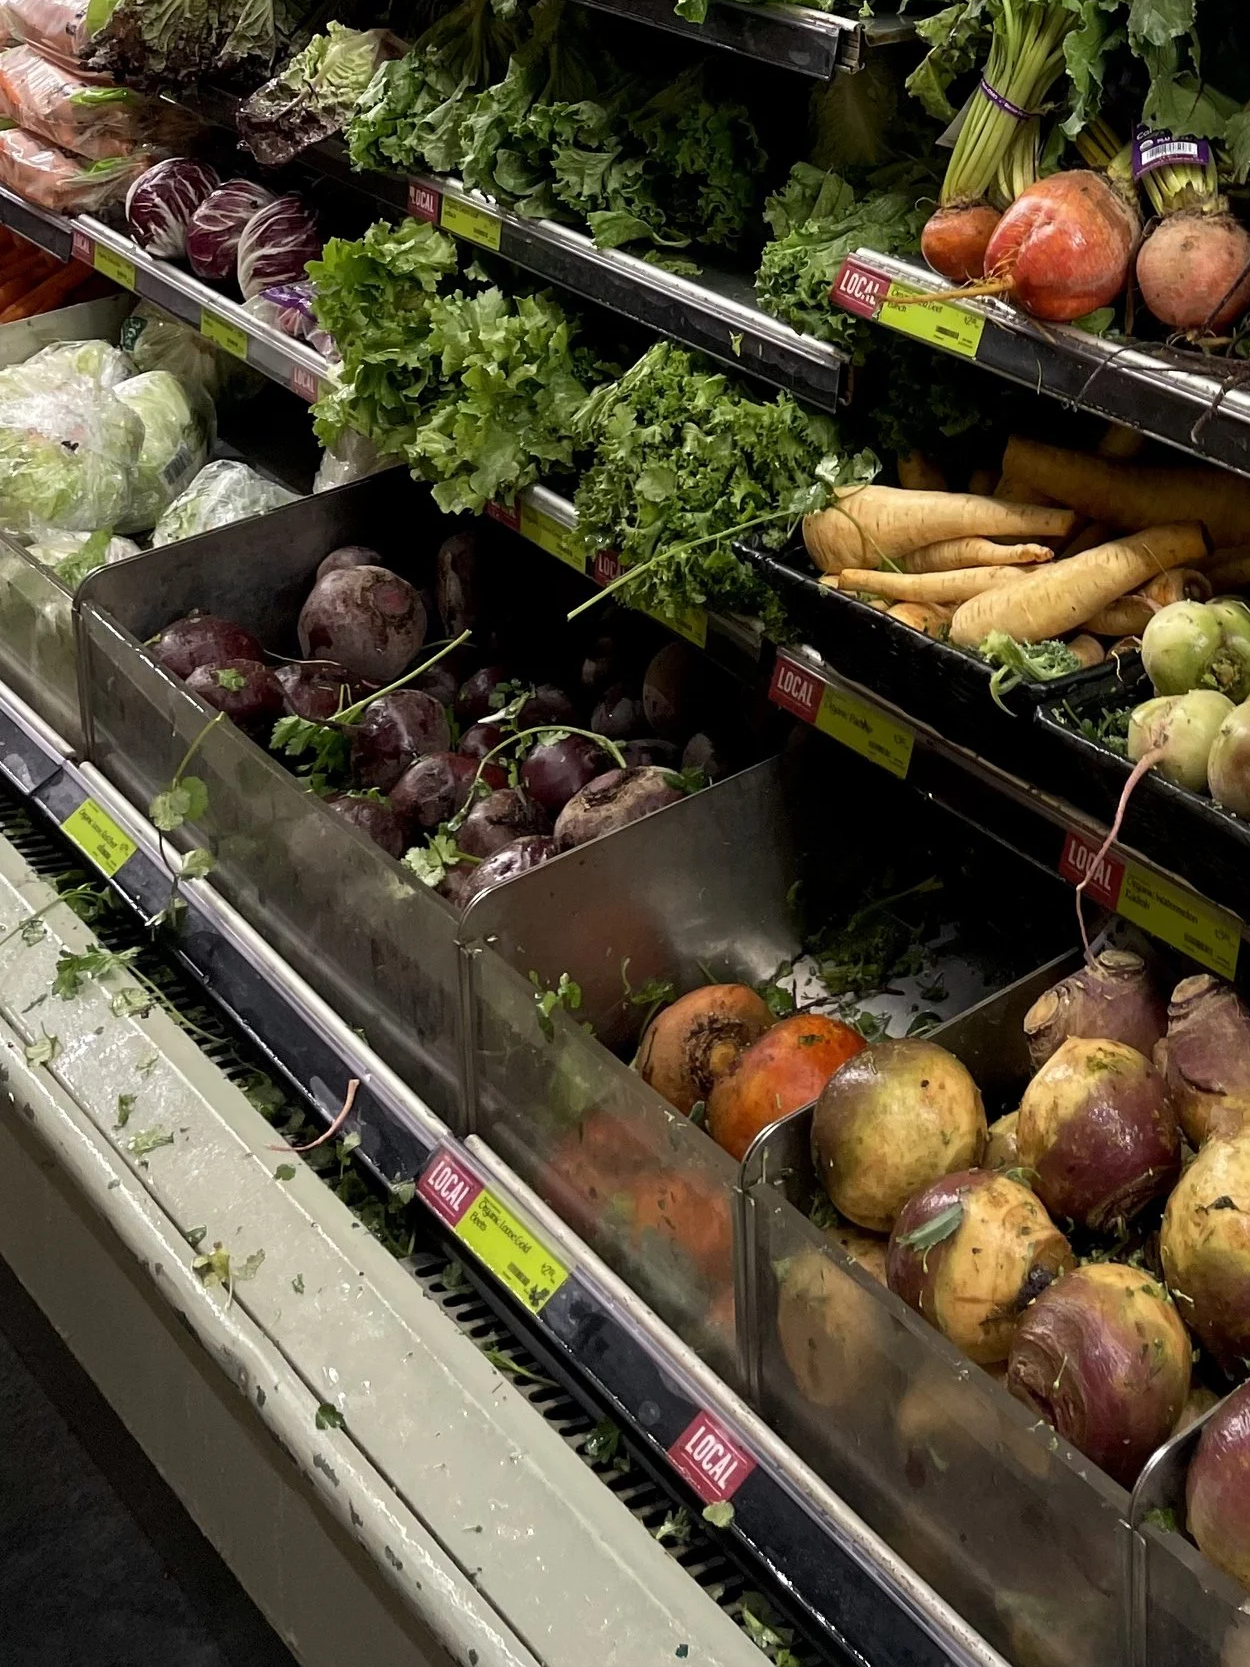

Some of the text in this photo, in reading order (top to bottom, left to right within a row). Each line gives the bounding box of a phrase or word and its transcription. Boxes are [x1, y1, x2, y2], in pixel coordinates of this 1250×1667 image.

[411, 187, 434, 213] LOCAL
[839, 269, 880, 306] LOCAL
[777, 667, 814, 708] LOCAL
[428, 1160, 470, 1212] LOCAL
[478, 1201, 501, 1227] Organic
[684, 1425, 739, 1490] LOCAL
